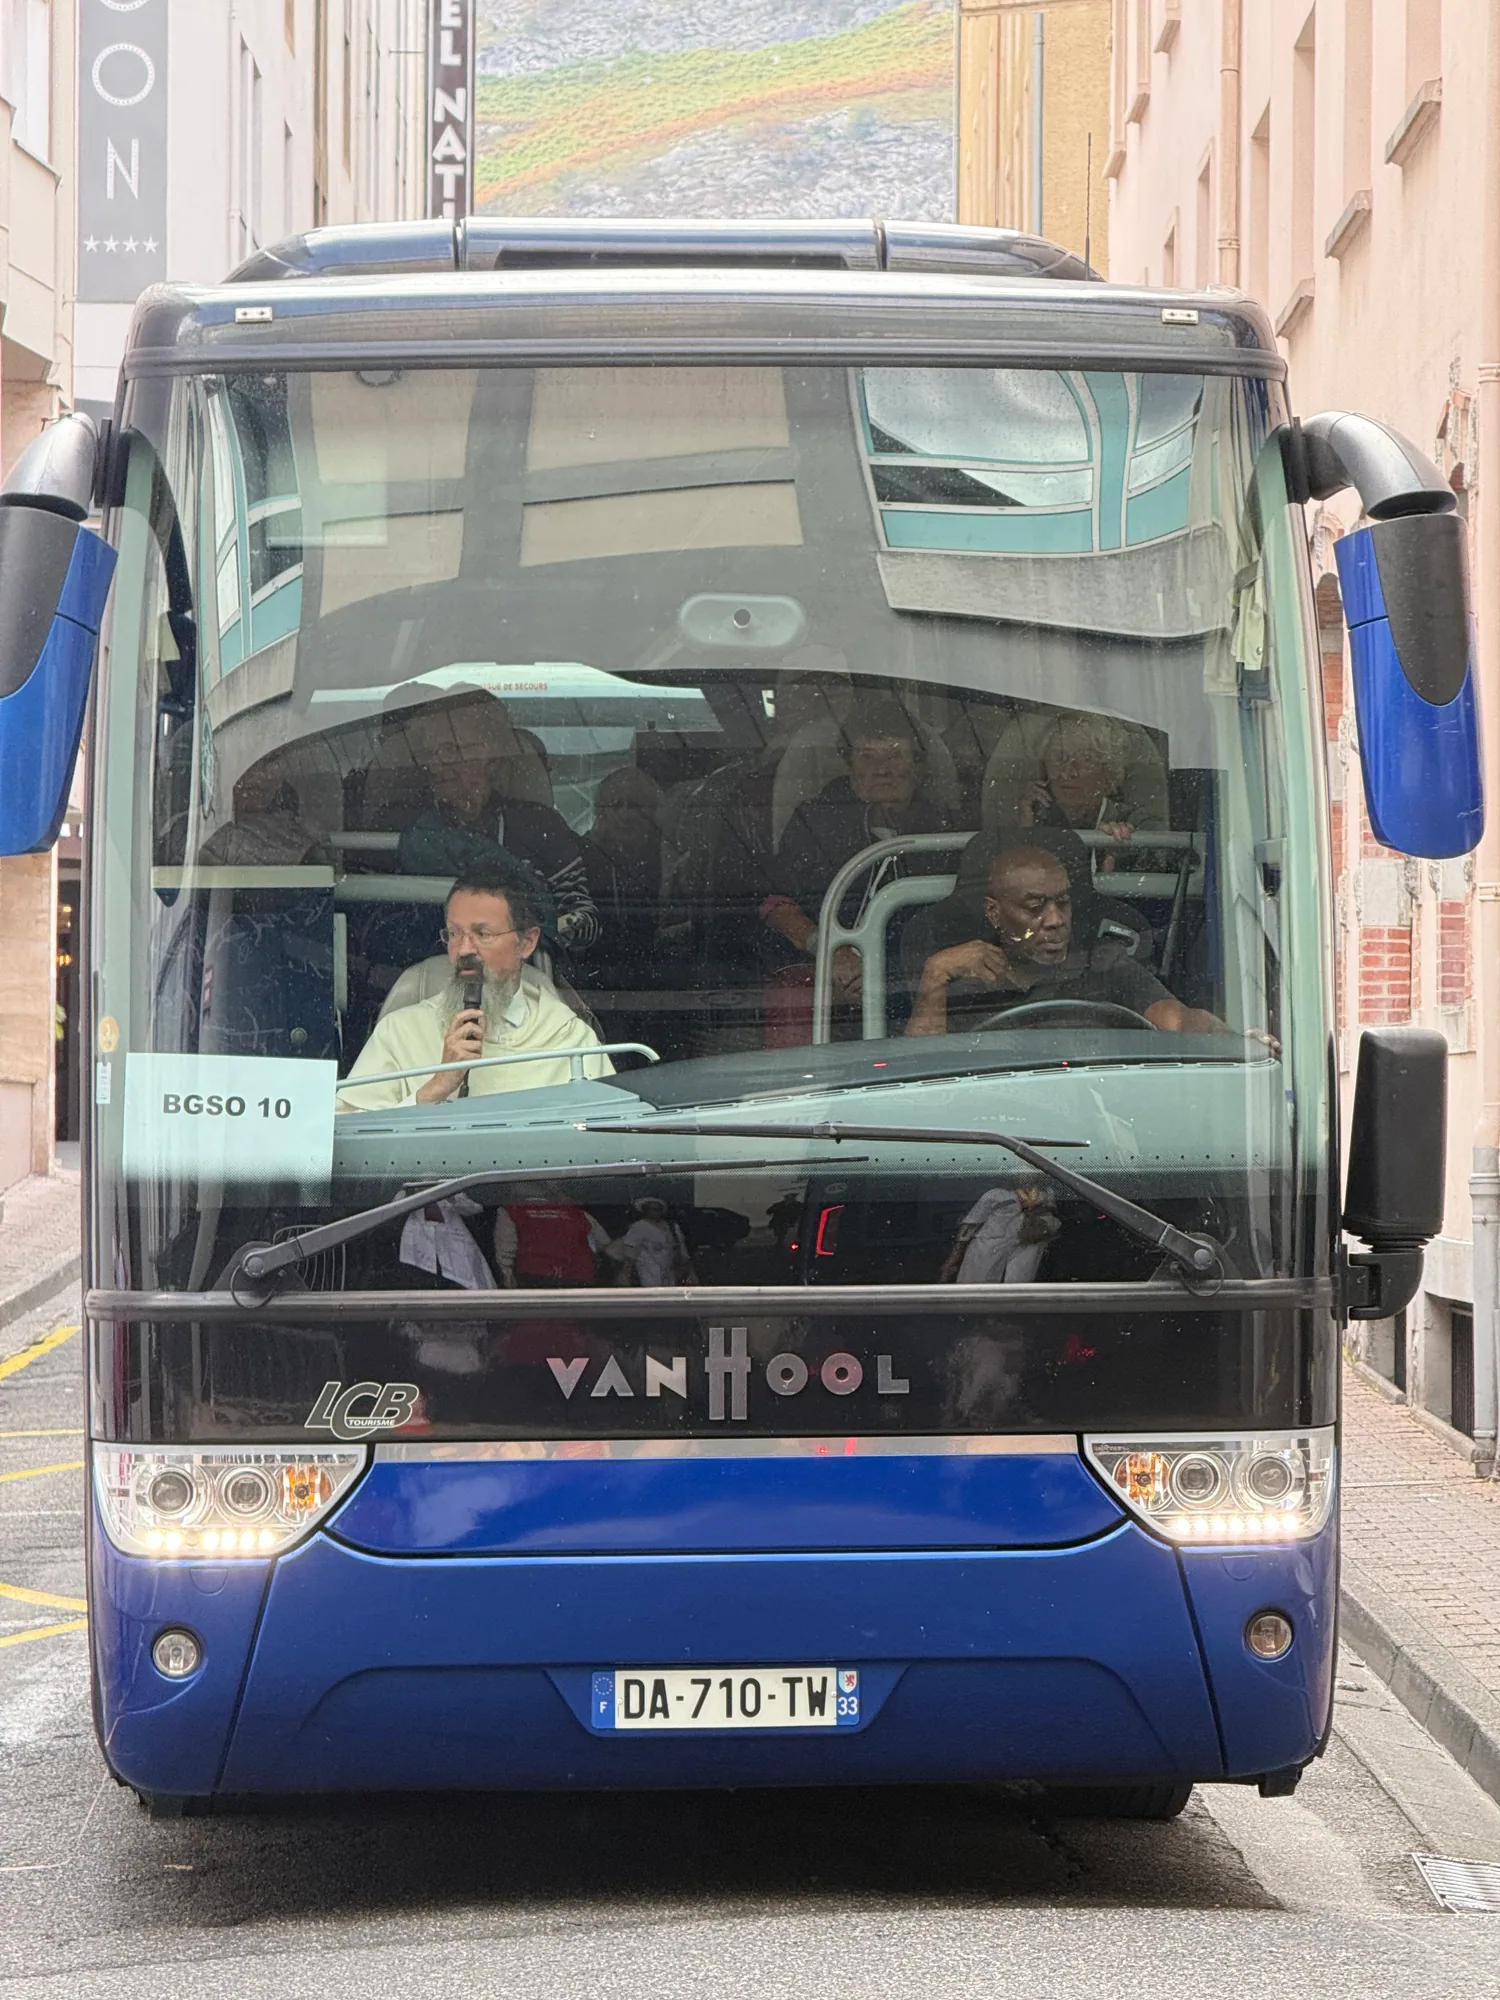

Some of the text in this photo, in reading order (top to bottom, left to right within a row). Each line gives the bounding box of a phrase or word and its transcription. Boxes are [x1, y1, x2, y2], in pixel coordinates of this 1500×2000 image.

[515, 683, 548, 691] SECOURS
[163, 1094, 291, 1119] BGSO 10
[304, 1381, 420, 1440] LCB
[349, 1419, 396, 1427] TOURISME
[624, 1676, 828, 1719] DA-710-TW
[837, 1697, 858, 1715] 33
[600, 1702, 608, 1714] F
